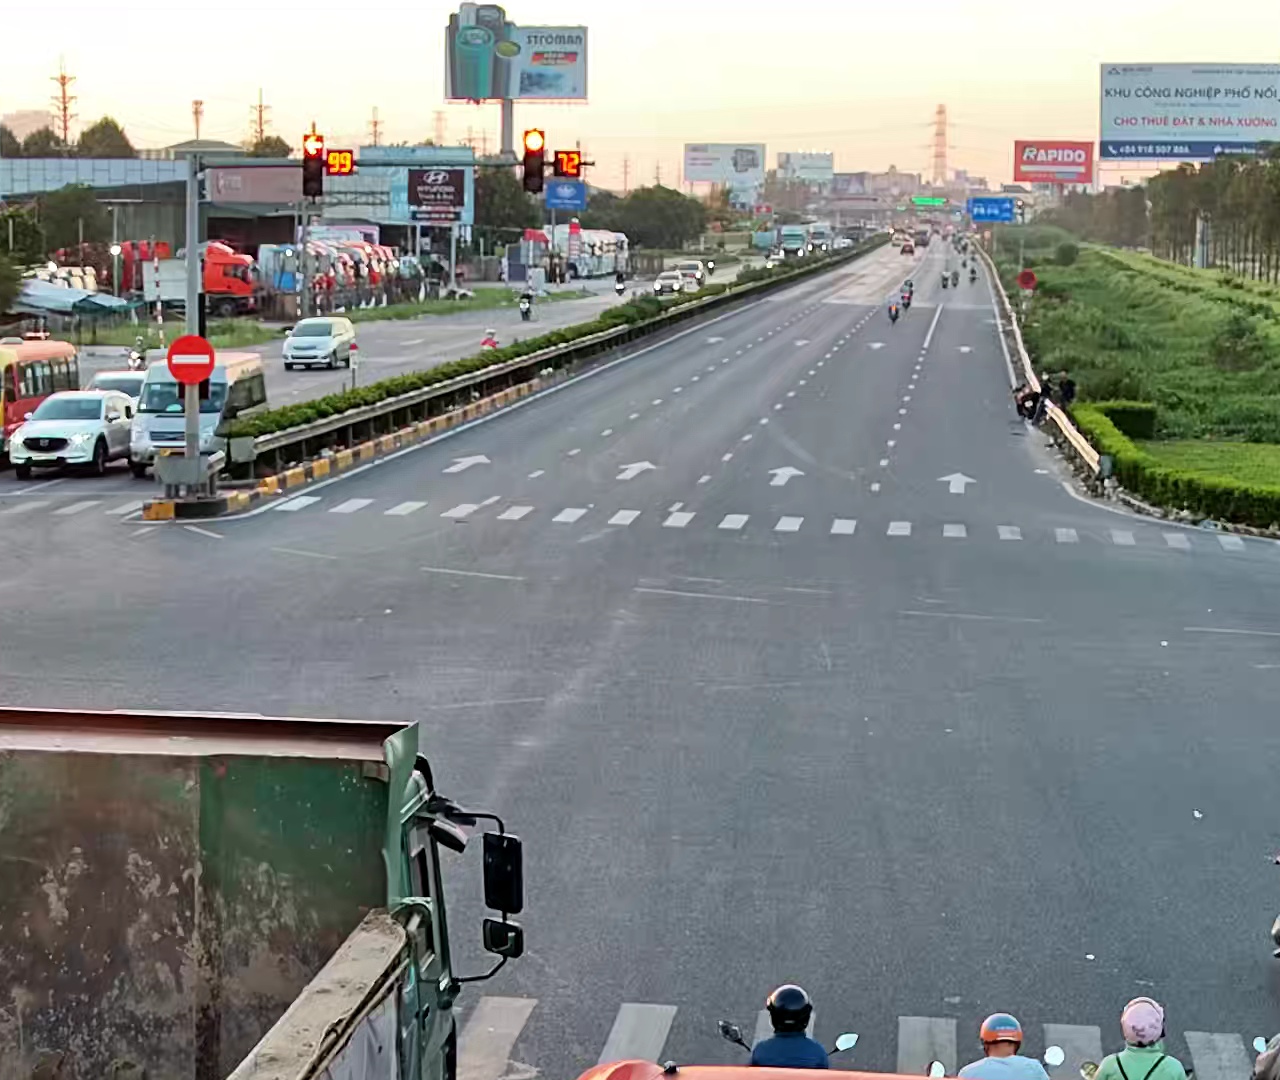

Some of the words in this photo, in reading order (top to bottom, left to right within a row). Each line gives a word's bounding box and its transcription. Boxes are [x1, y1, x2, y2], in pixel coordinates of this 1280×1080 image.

[1104, 88, 1131, 98] KHU
[1134, 86, 1171, 98] CÔNG
[1174, 86, 1221, 100] NGHIỆP
[1114, 117, 1138, 126] CHO
[1141, 116, 1169, 126] THUÊ
[1198, 117, 1206, 126] &
[327, 152, 352, 173] 99
[1023, 147, 1086, 163] RAPIDO
[558, 153, 578, 174] 72
